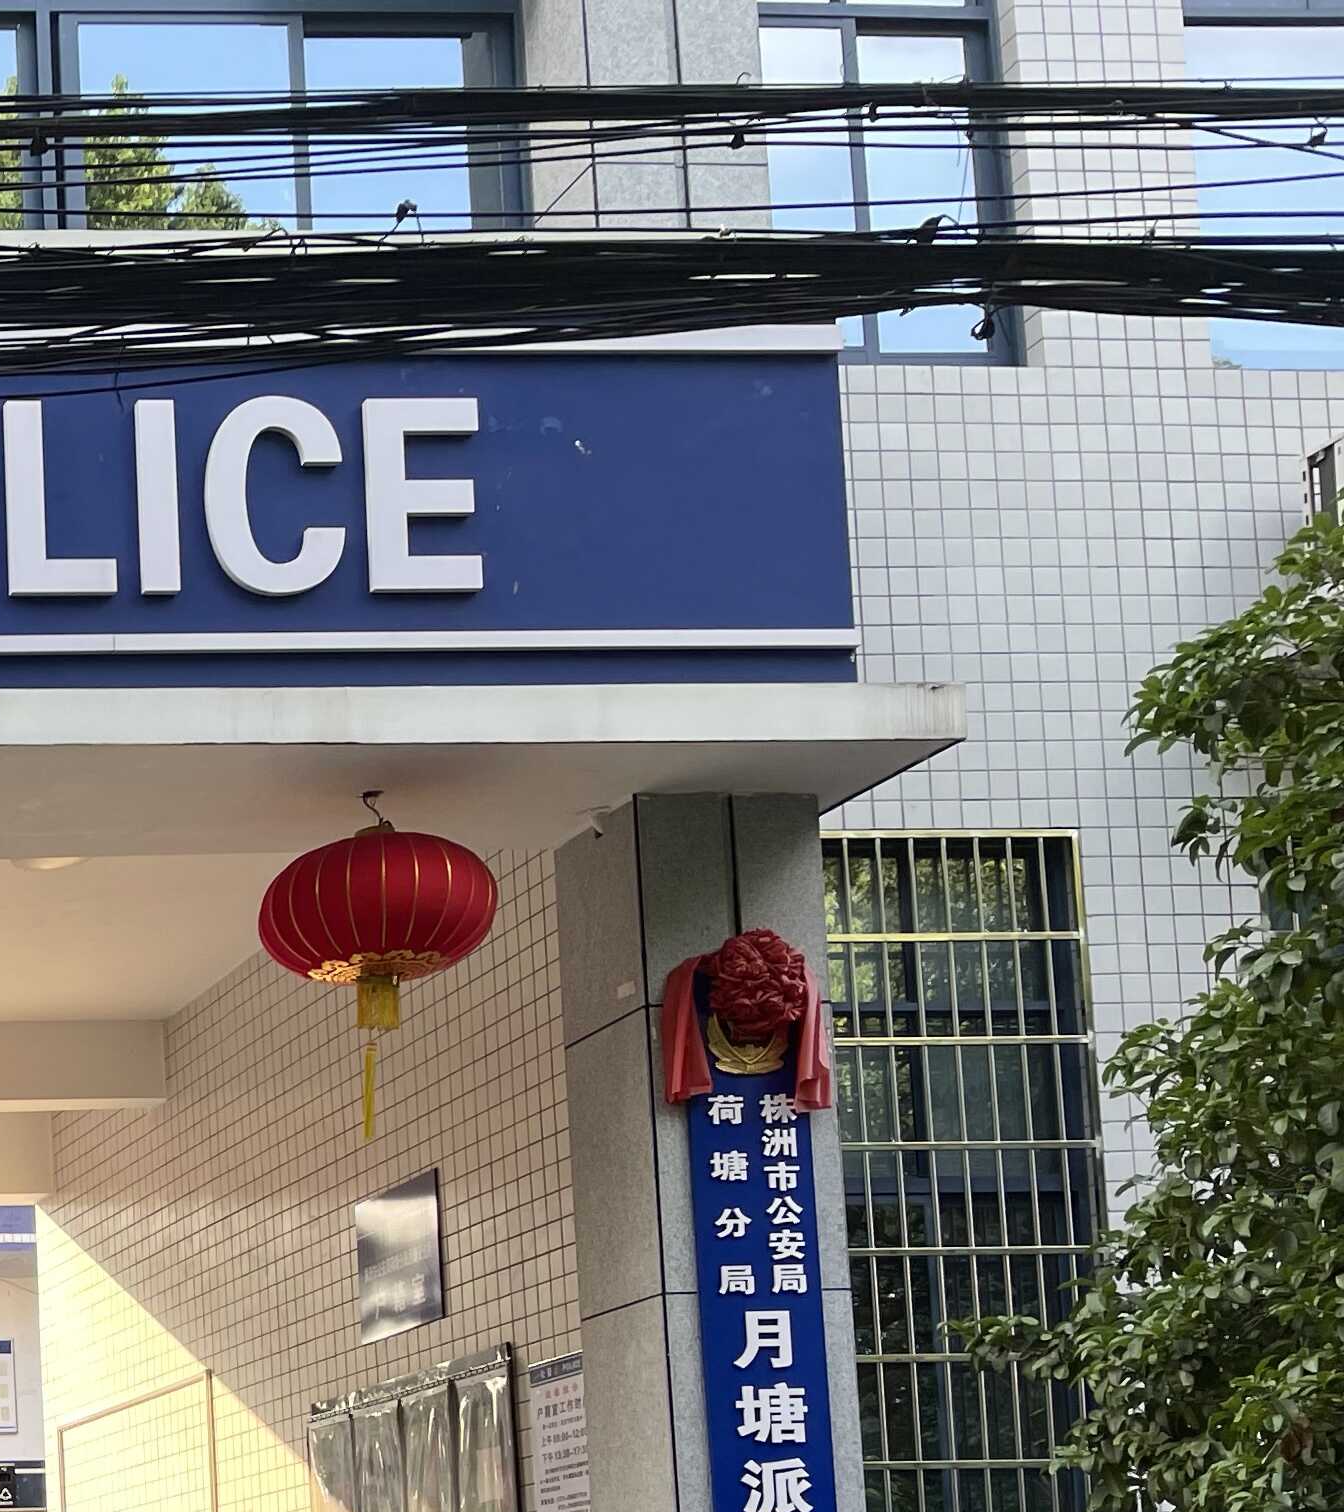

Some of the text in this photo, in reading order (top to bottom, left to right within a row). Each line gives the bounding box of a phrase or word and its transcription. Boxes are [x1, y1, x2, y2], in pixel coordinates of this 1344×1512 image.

[708, 1094, 756, 1295] 荷塘分局
[759, 1093, 808, 1294] 株洲市公安局
